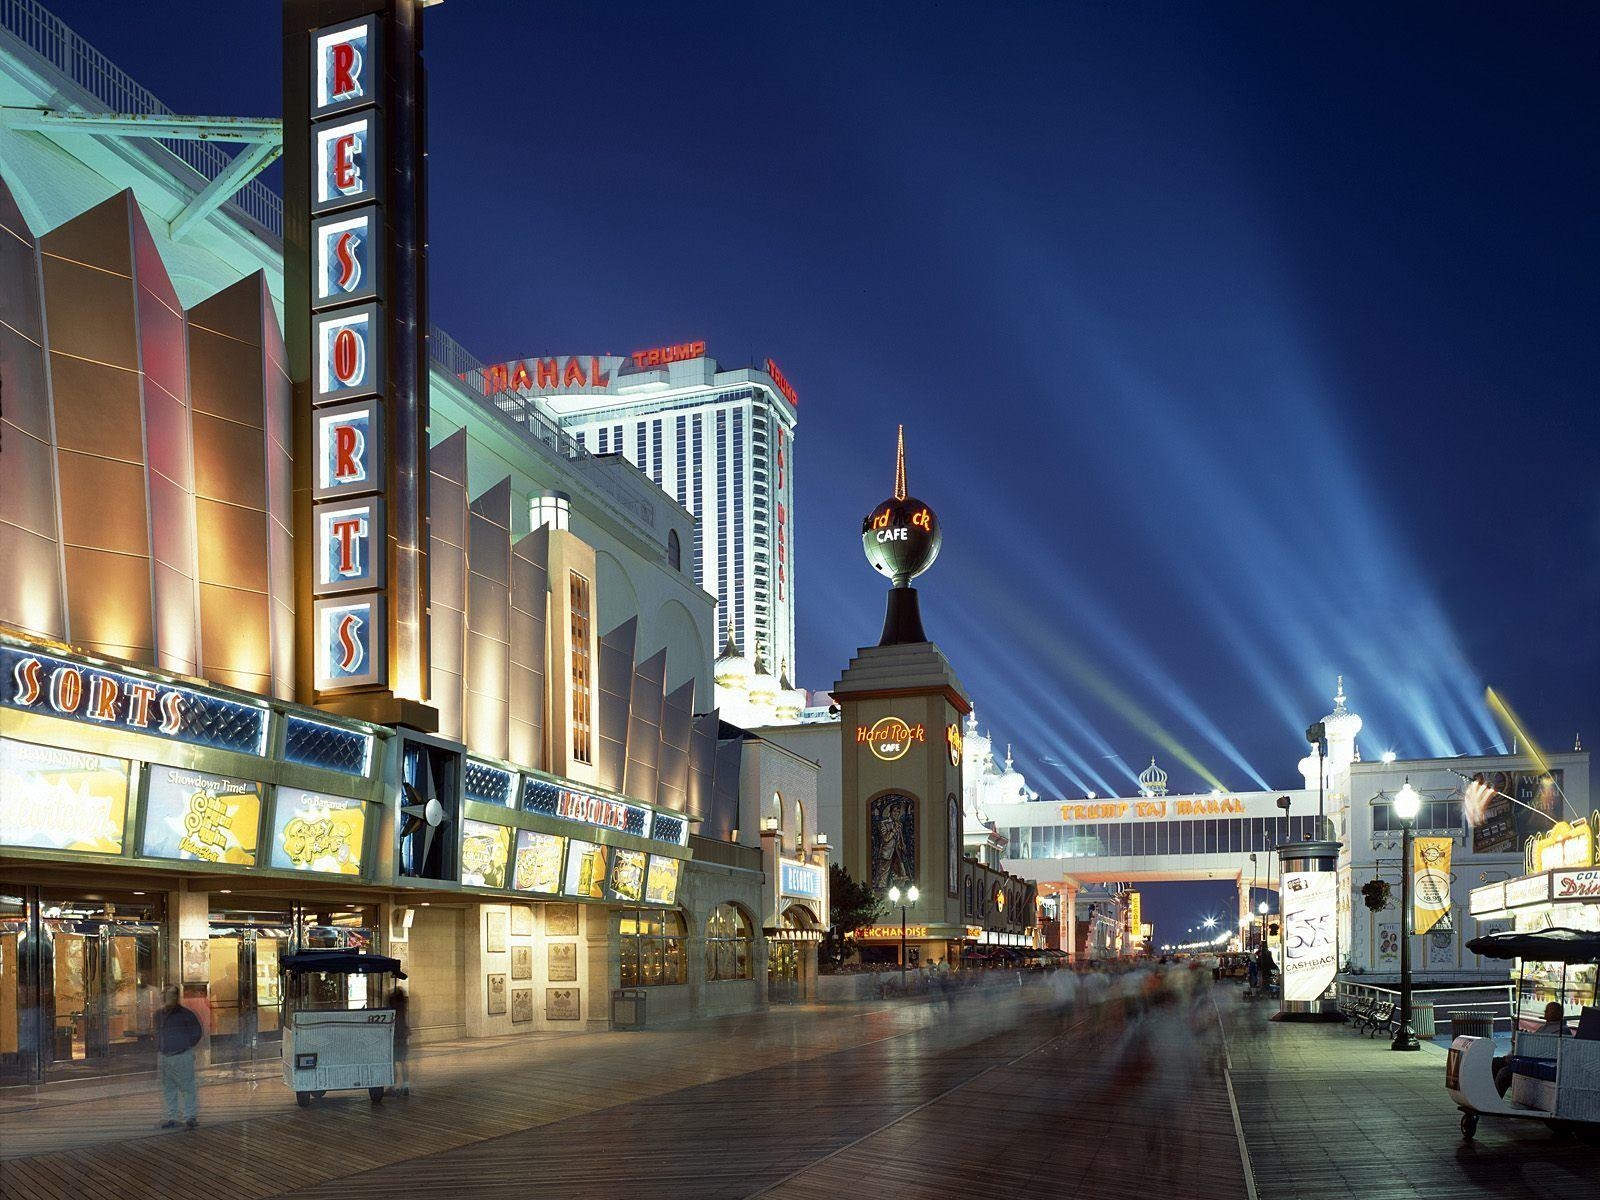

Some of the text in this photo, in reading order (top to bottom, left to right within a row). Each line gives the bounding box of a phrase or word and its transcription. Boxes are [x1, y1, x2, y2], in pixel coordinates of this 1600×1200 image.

[332, 41, 367, 674] RESORTS
[632, 340, 705, 367] TRUMP
[483, 356, 611, 397] MAHAL
[768, 358, 799, 407] TRUMP
[876, 527, 908, 543] CAFE
[13, 656, 182, 736] SORTS
[857, 725, 890, 743] Hard
[891, 723, 925, 743] Rock
[880, 743, 901, 753] CAFE
[167, 770, 247, 795] Showdown Time!
[300, 793, 313, 806] Go
[556, 790, 629, 831] RESORTS
[1060, 798, 1246, 821] TRUMP TAJ MAHAL
[1285, 954, 1336, 973] CASHBACK
[368, 1014, 387, 1024] 827
